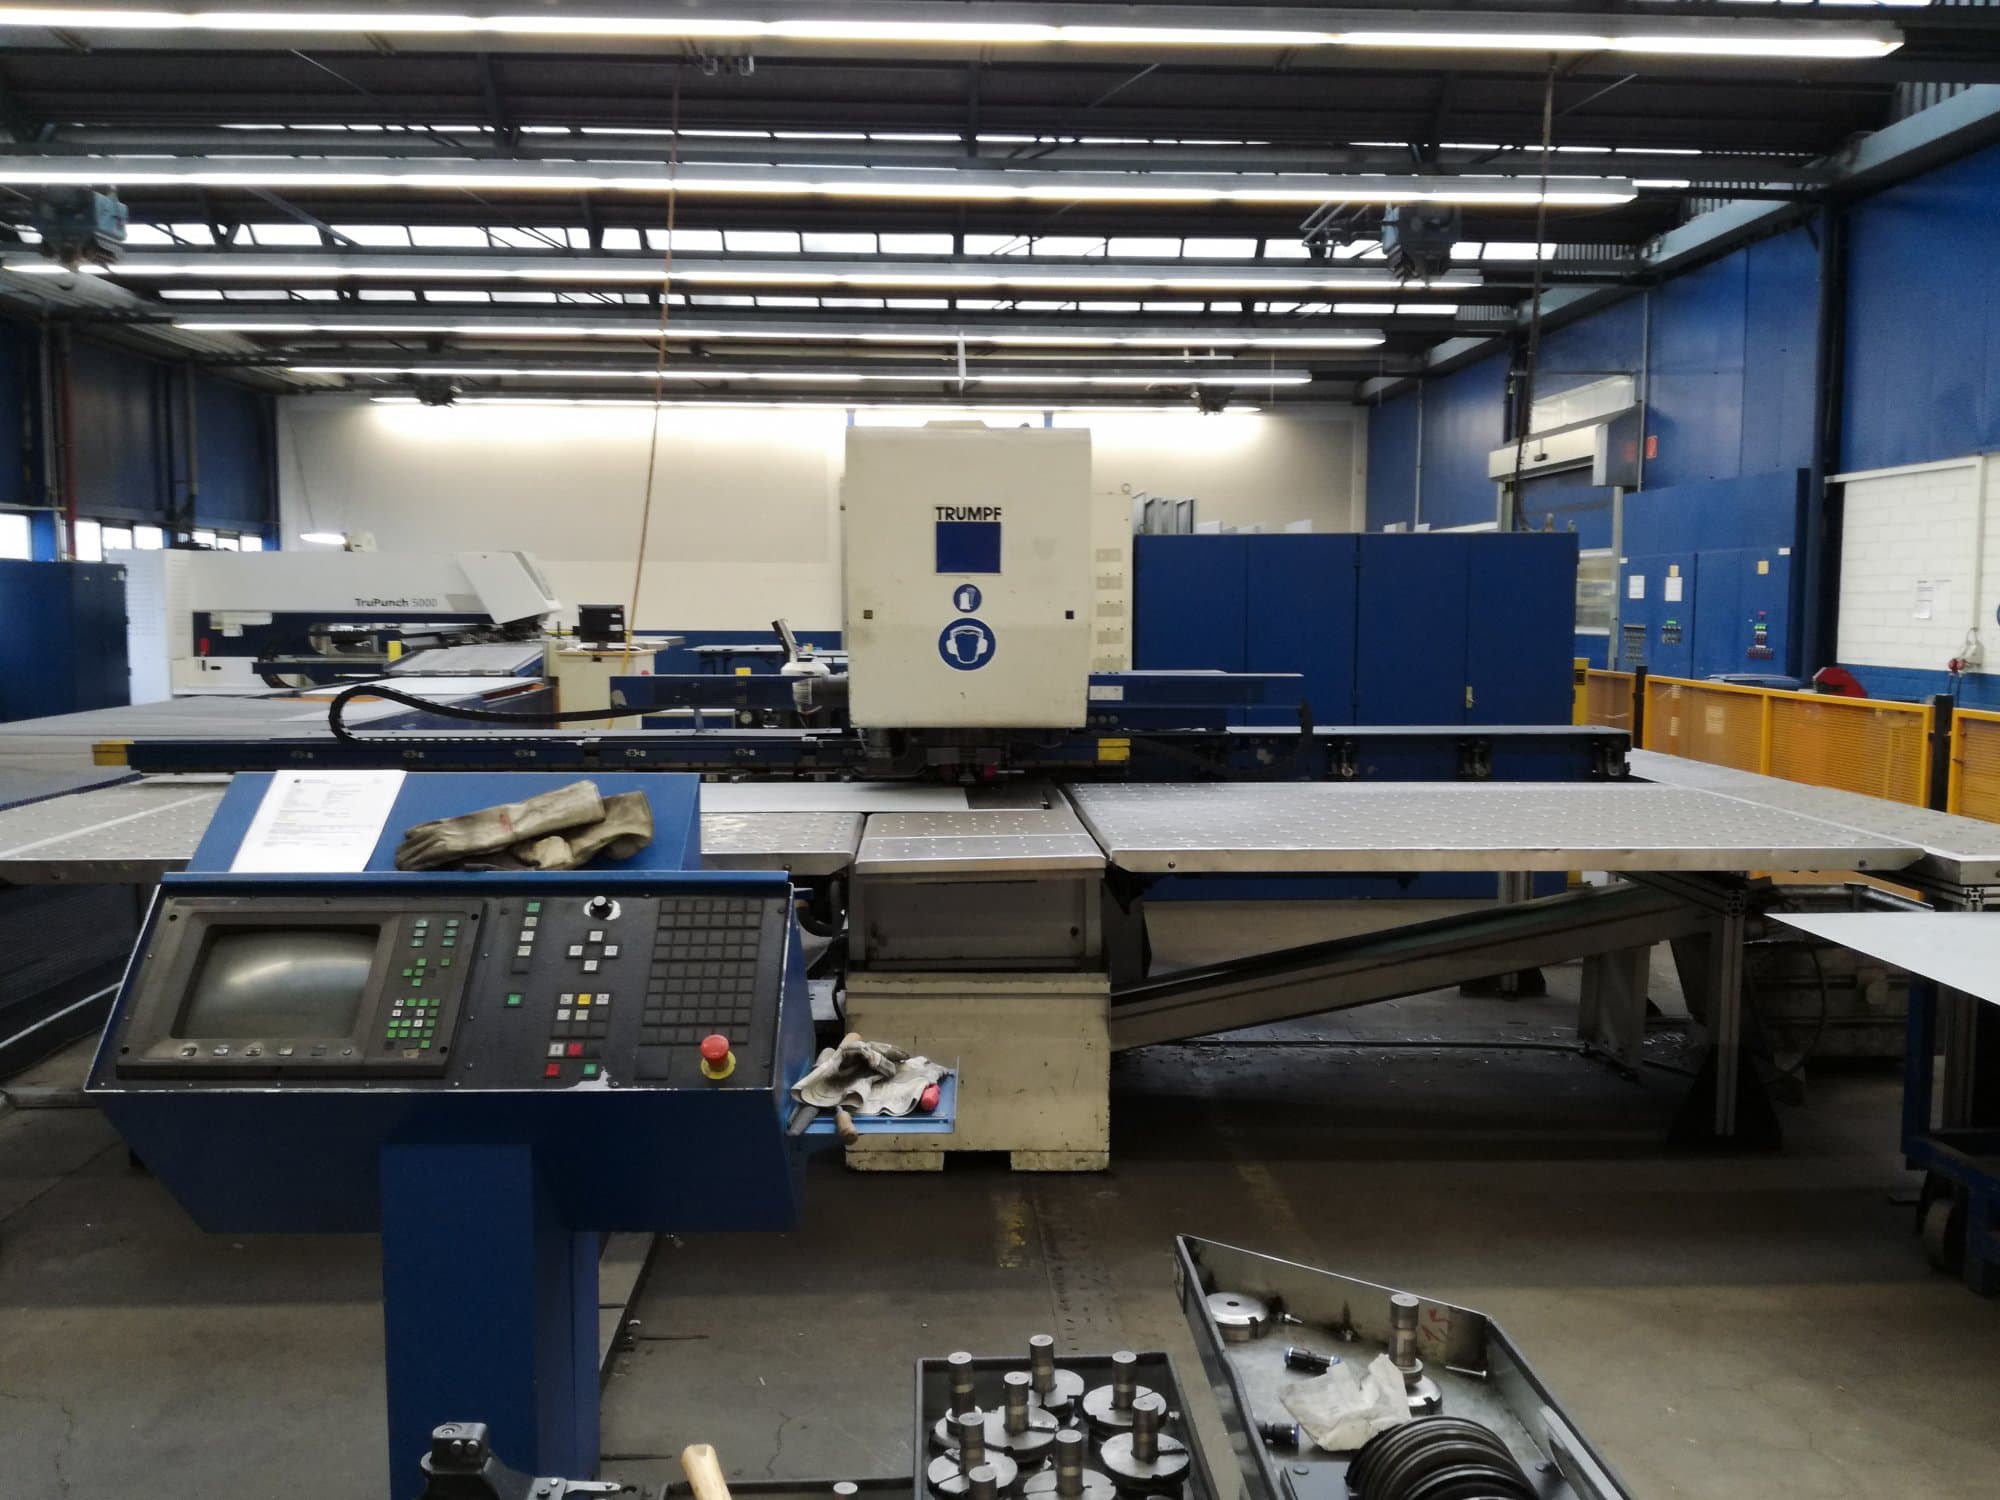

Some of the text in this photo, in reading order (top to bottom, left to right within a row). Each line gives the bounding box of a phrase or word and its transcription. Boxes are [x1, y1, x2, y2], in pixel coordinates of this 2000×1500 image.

[935, 506, 1002, 521] TRUMPF
[354, 598, 438, 608] TruPunch 5000
